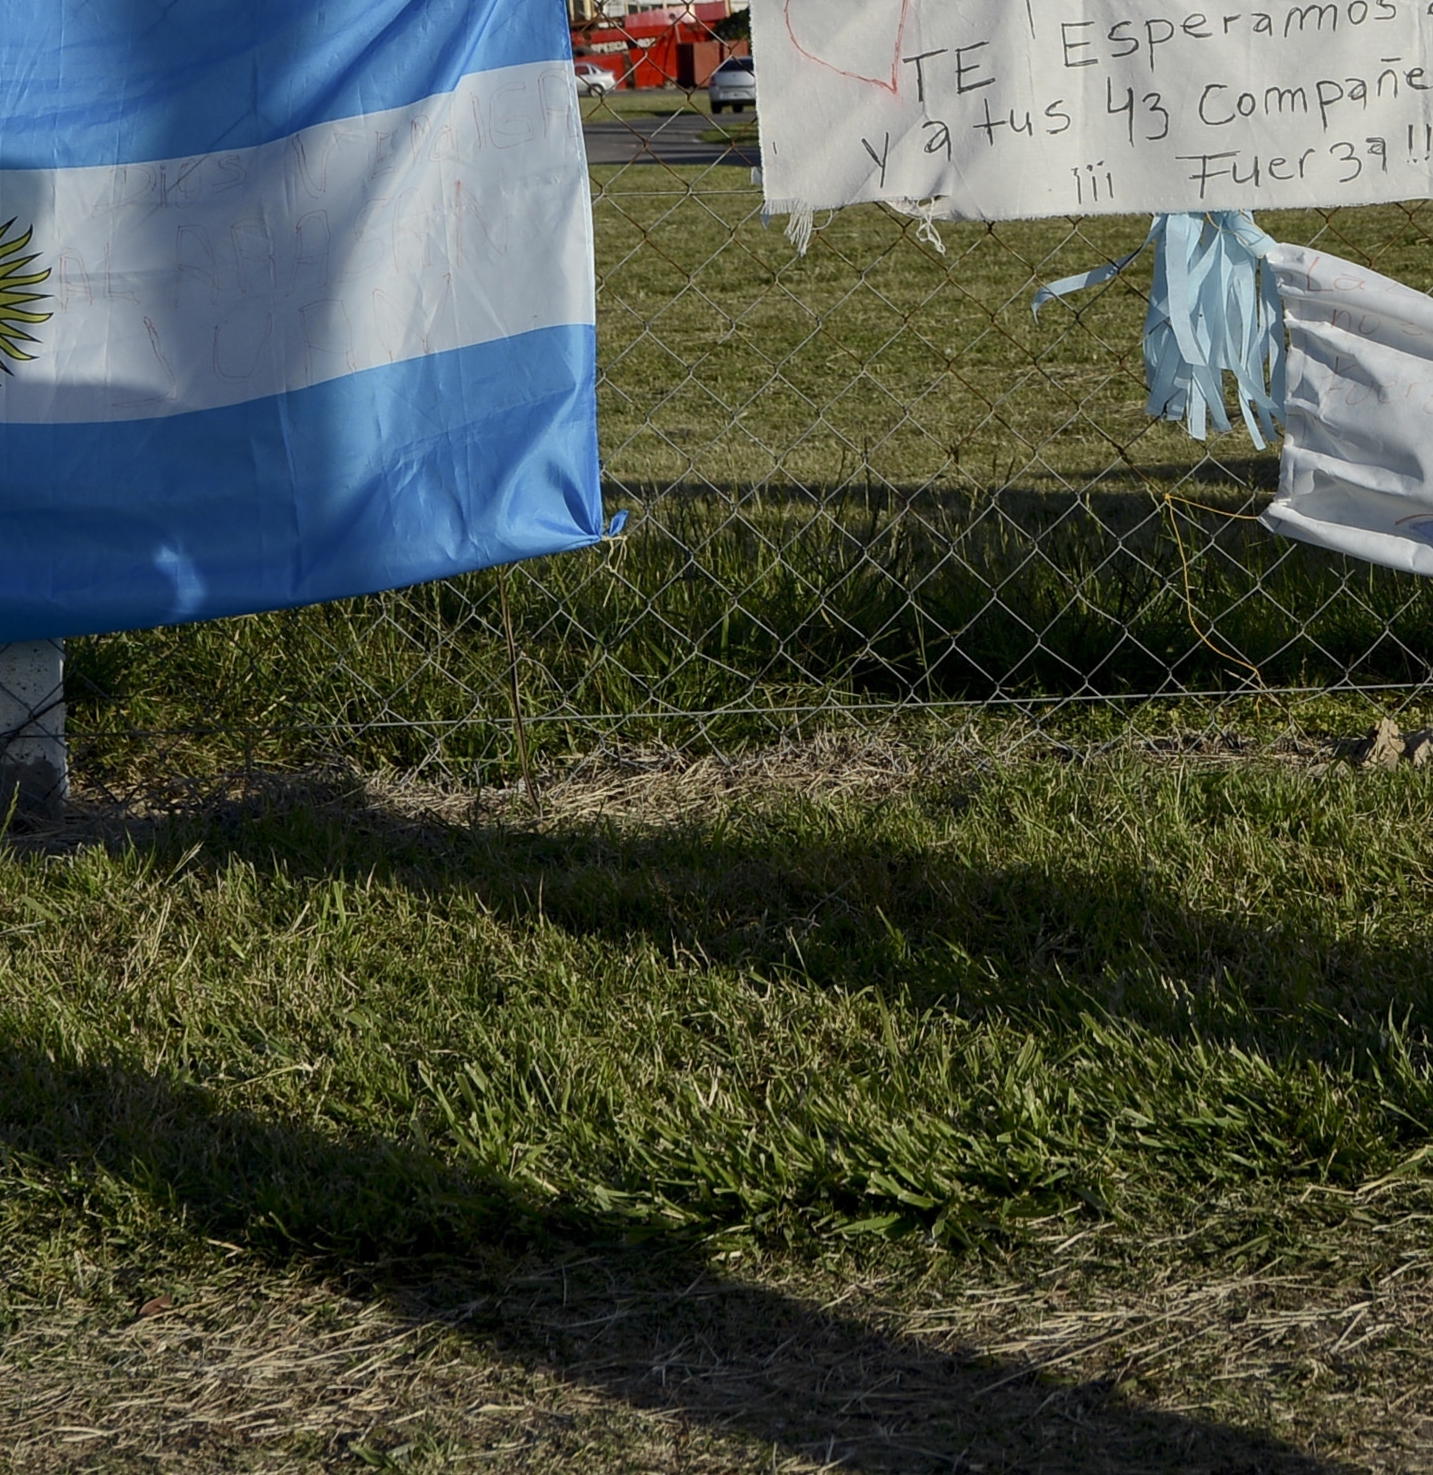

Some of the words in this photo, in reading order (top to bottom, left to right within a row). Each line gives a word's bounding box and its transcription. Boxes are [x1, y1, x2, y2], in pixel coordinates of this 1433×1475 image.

[902, 41, 996, 103] TE
[922, 119, 952, 162] a
[972, 97, 1072, 147] tus
[1106, 76, 1170, 148] 43
